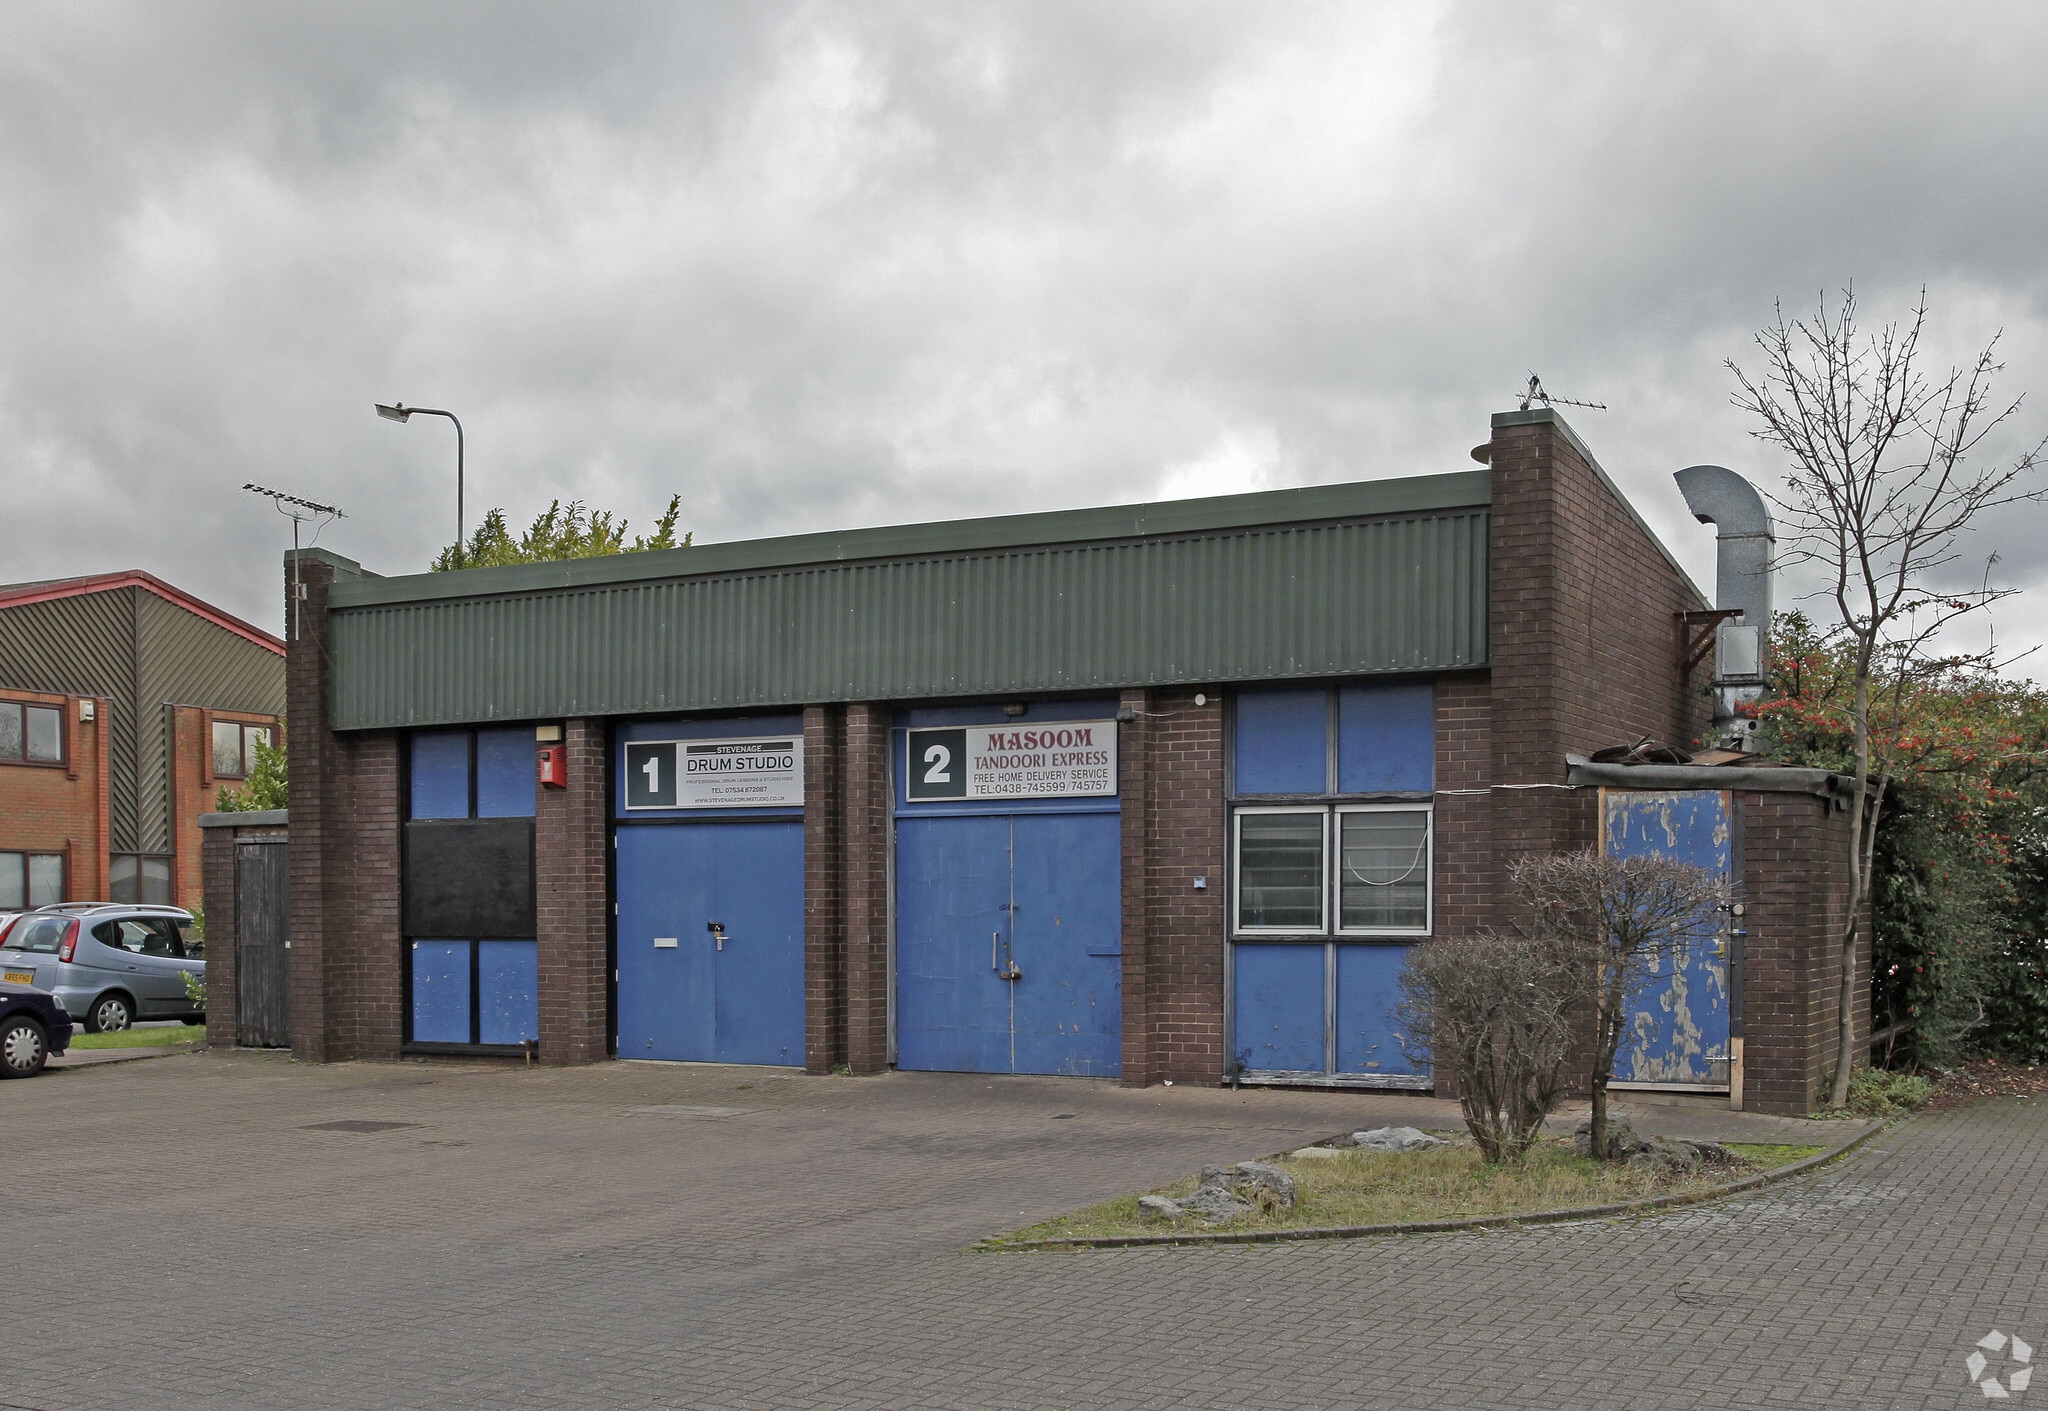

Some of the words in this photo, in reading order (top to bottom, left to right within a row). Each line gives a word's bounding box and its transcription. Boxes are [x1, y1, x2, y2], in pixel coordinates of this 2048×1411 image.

[716, 745, 762, 754] STEVENAGE
[987, 728, 1093, 752] MASOOM
[687, 758, 732, 772] DRUM
[735, 755, 794, 770] STUDIO
[923, 744, 951, 784] 2
[974, 754, 1046, 770] TANDOORI
[1052, 751, 1108, 767] EXPRESS
[642, 757, 659, 793] 1
[973, 773, 995, 783] FREE
[998, 772, 1023, 782] HOME
[1026, 770, 1067, 781] DELIVERY
[1071, 768, 1108, 779] SERVICE
